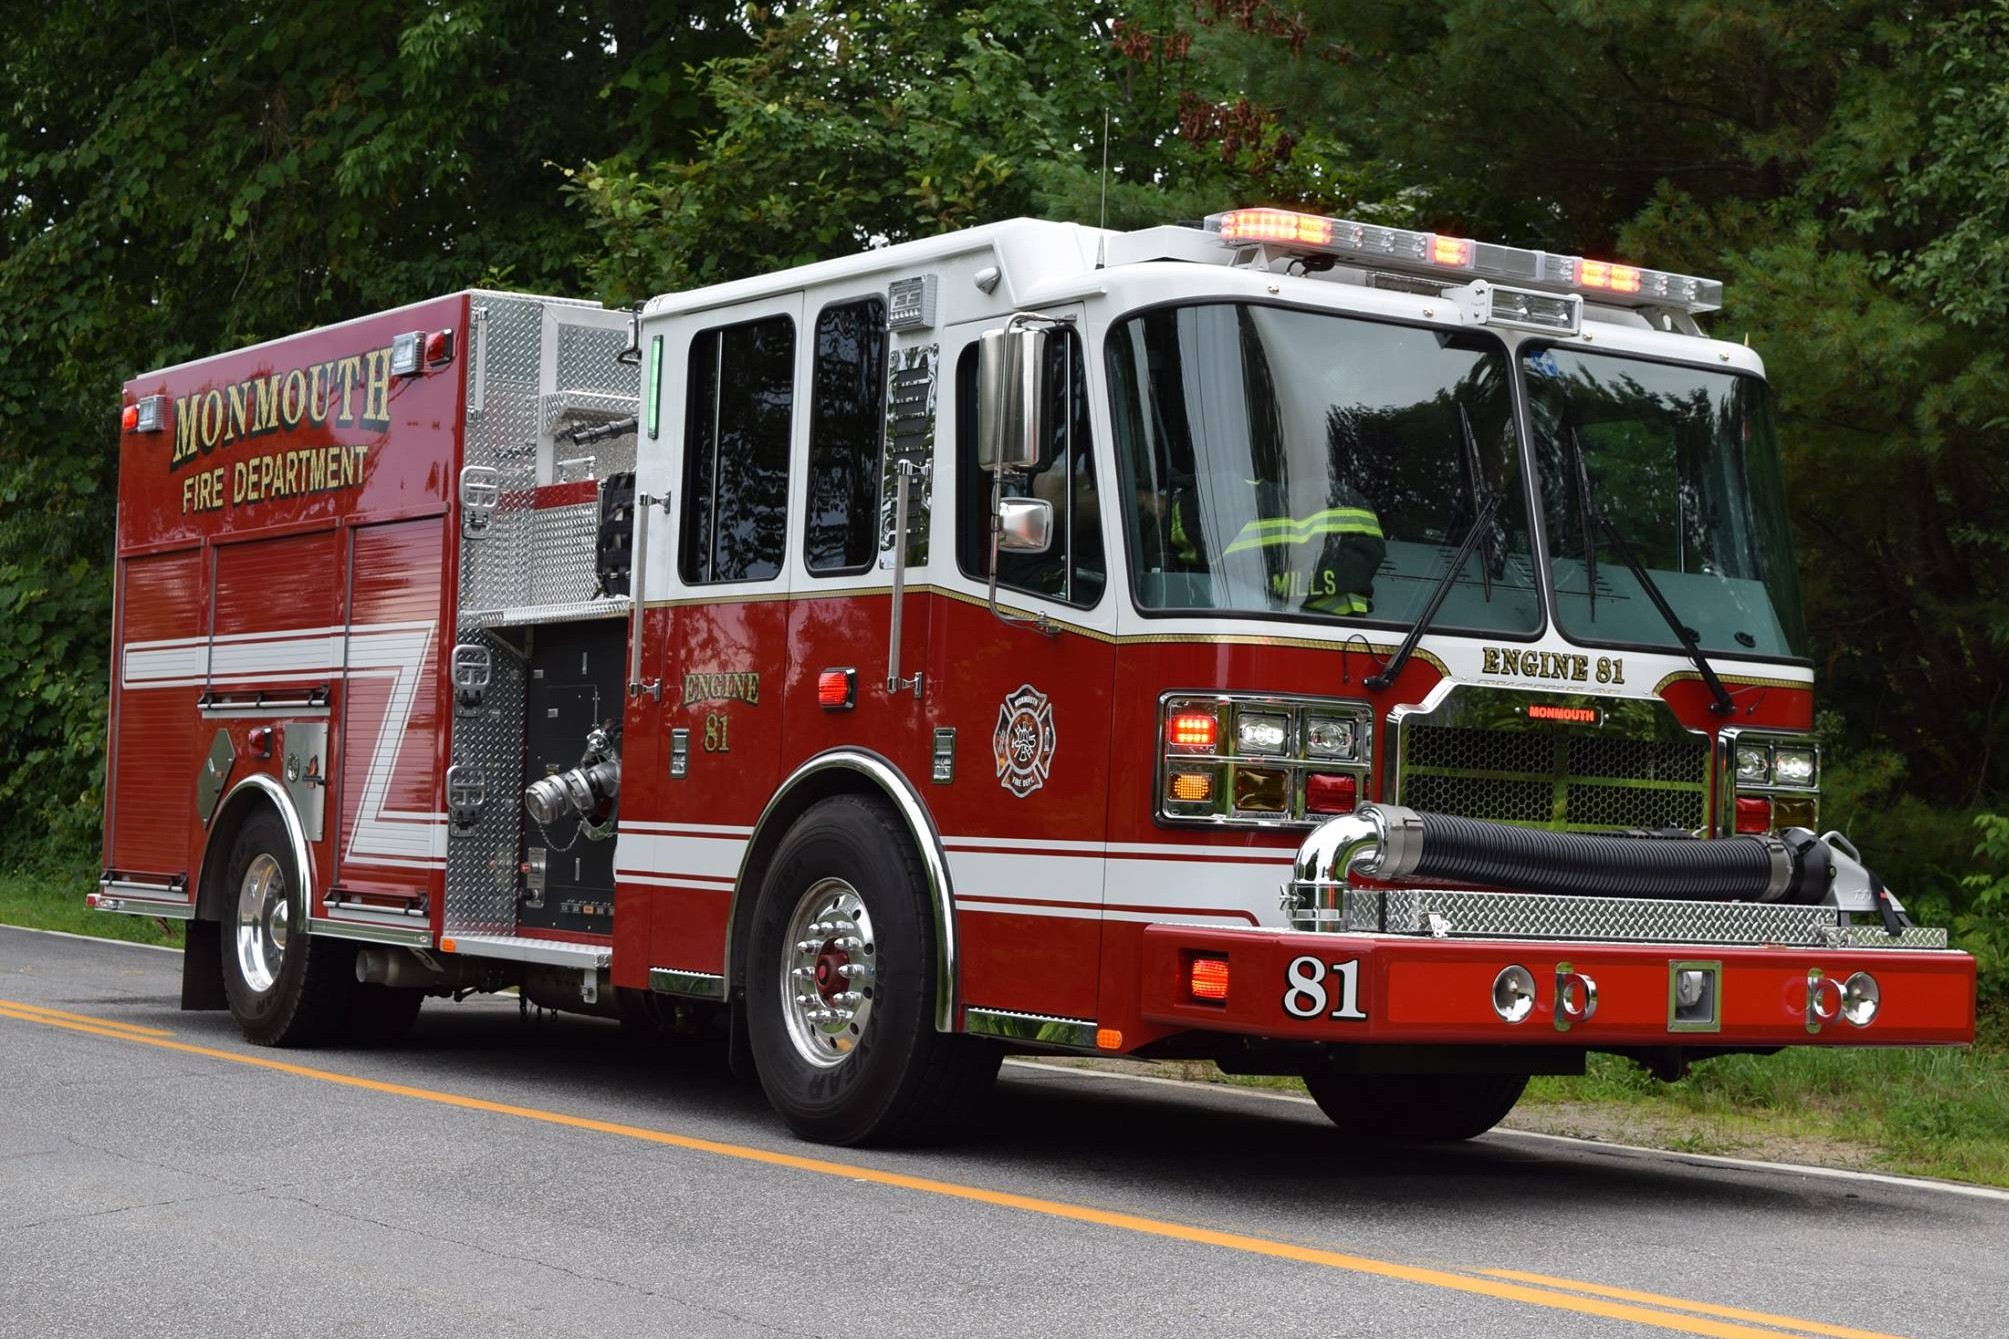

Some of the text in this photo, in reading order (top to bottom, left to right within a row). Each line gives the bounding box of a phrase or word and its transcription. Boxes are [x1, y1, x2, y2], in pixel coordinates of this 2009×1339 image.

[171, 347, 394, 467] MONMOUTH
[182, 445, 369, 514] FIRE DEPARTMENT
[1273, 570, 1336, 597] MILLS
[1482, 647, 1625, 685] ENGINE 81
[683, 672, 760, 705] ENGINE
[704, 713, 729, 752] 81
[1528, 705, 1595, 722] MONMOUTH
[1283, 955, 1368, 1019] 81
